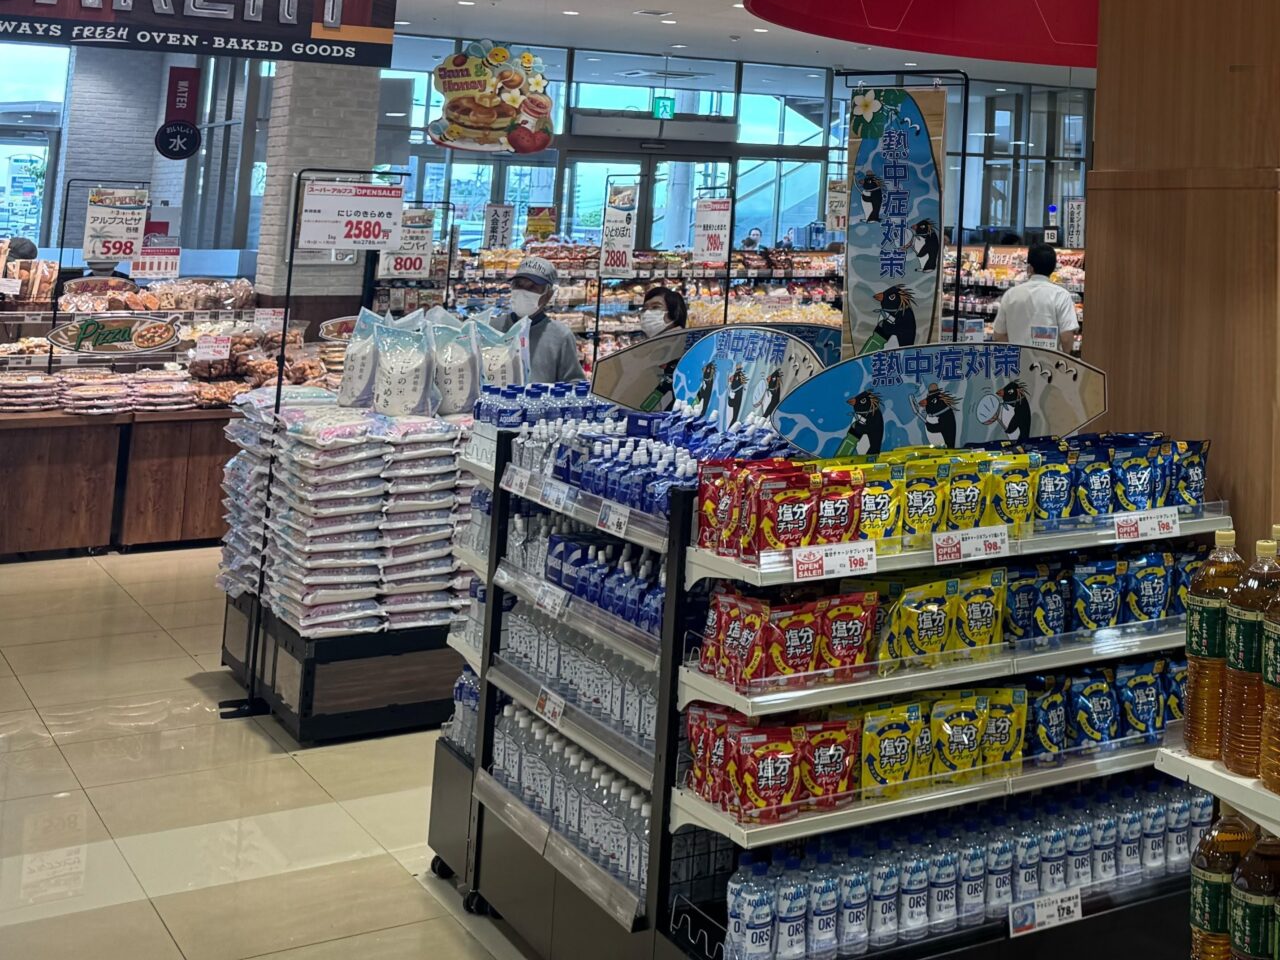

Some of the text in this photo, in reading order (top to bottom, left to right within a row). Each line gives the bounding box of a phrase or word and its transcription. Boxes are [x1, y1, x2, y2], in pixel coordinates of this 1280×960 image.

[72, 26, 129, 41] FRESH
[291, 42, 356, 58] GOODS
[176, 80, 189, 109] WATER
[168, 134, 187, 151] 水
[880, 129, 909, 278] 熱中症対策
[100, 240, 134, 255] 598
[393, 257, 422, 271] 800
[74, 319, 131, 351] Pizza
[717, 330, 790, 364] 熱中症対策
[871, 346, 1022, 387] 熱中症対策
[1005, 481, 1028, 499] 塩分
[1041, 476, 1069, 491] 塩分
[861, 493, 891, 511] 塩分
[908, 490, 936, 509] 塩分
[951, 486, 980, 504] 塩分
[777, 503, 807, 521] 塩分
[819, 499, 849, 517] 塩分
[983, 541, 998, 551] 198
[798, 563, 819, 571] OPEN
[848, 558, 864, 568] 198
[1089, 587, 1115, 603] 塩分
[1140, 579, 1165, 596] 塩分
[917, 610, 946, 627] 塩分
[967, 602, 994, 619] 塩分
[785, 628, 814, 645] 塩分
[832, 620, 863, 637] 塩分
[950, 725, 977, 742] 塩分
[814, 745, 846, 765] 塩分
[880, 739, 909, 757] 塩分
[758, 757, 791, 777] 塩分
